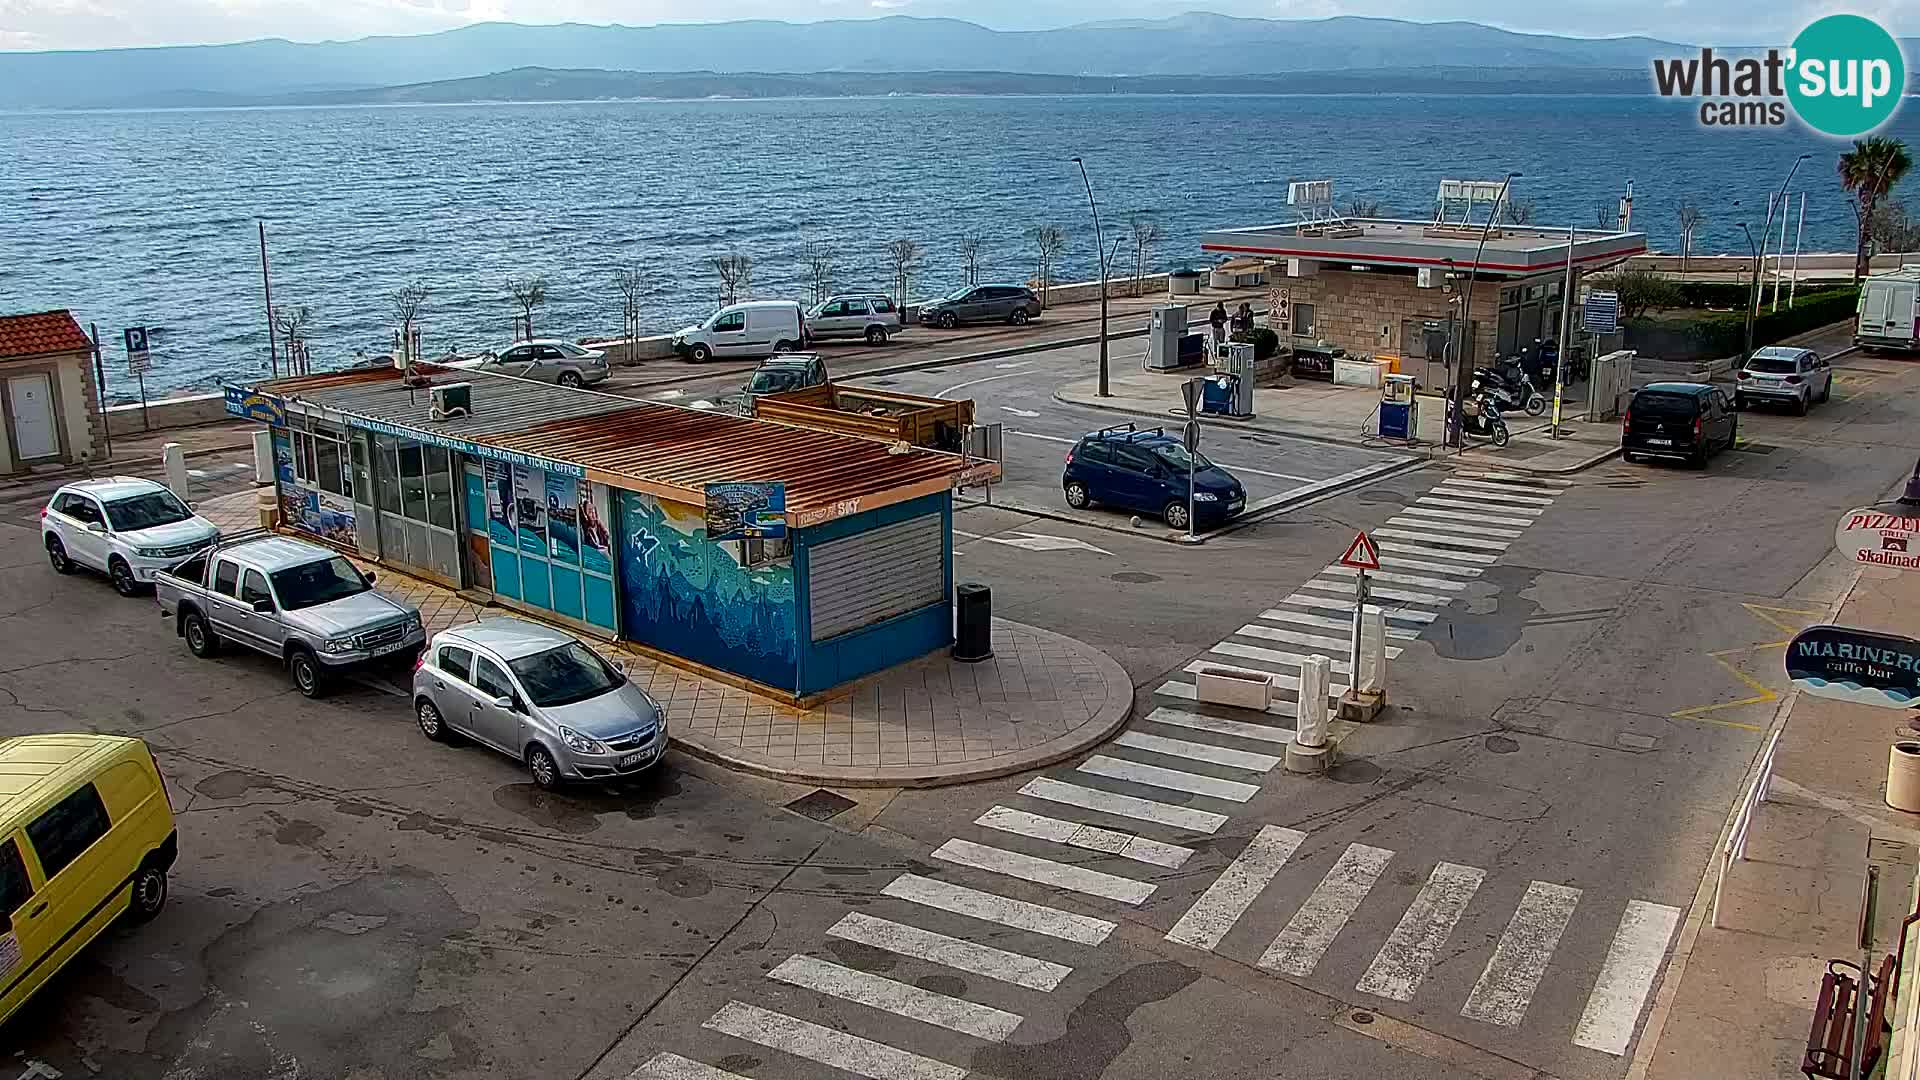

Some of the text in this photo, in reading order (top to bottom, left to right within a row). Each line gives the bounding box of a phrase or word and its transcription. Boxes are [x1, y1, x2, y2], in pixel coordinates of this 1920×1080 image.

[130, 330, 142, 348] P
[436, 435, 467, 451] POSTAJA
[477, 445, 492, 457] BUS
[492, 449, 525, 464] STATION
[527, 456, 554, 470] TICKET
[554, 462, 581, 477] OFFICE
[1879, 529, 1912, 540] GRILL
[1826, 661, 1895, 679] caffe bar
